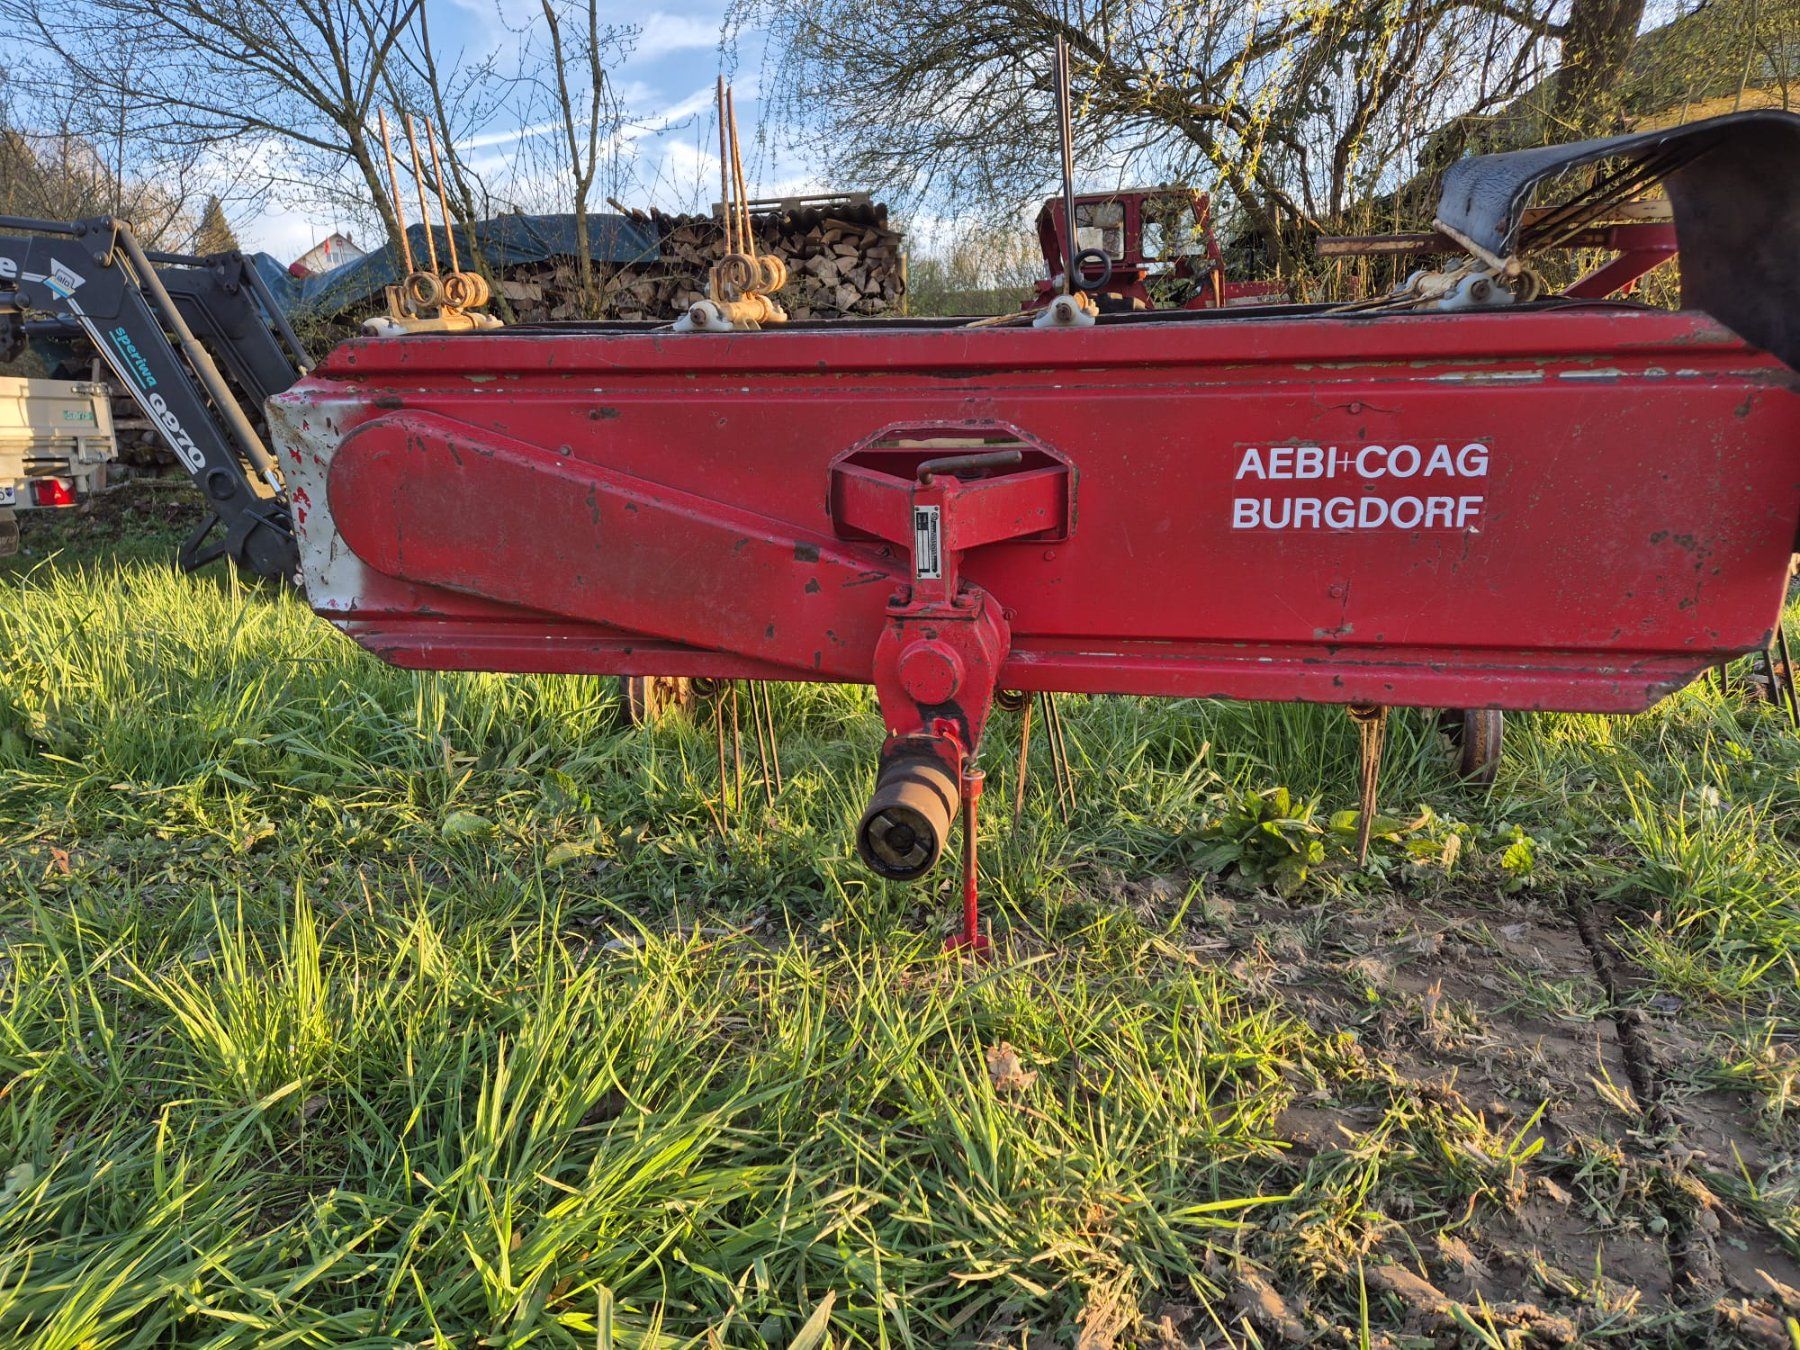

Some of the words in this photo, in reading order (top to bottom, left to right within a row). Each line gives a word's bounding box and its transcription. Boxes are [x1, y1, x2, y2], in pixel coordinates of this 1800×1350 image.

[115, 326, 157, 388] speriwa
[149, 392, 206, 469] Q970
[1232, 495, 1484, 529] BURGDORF
